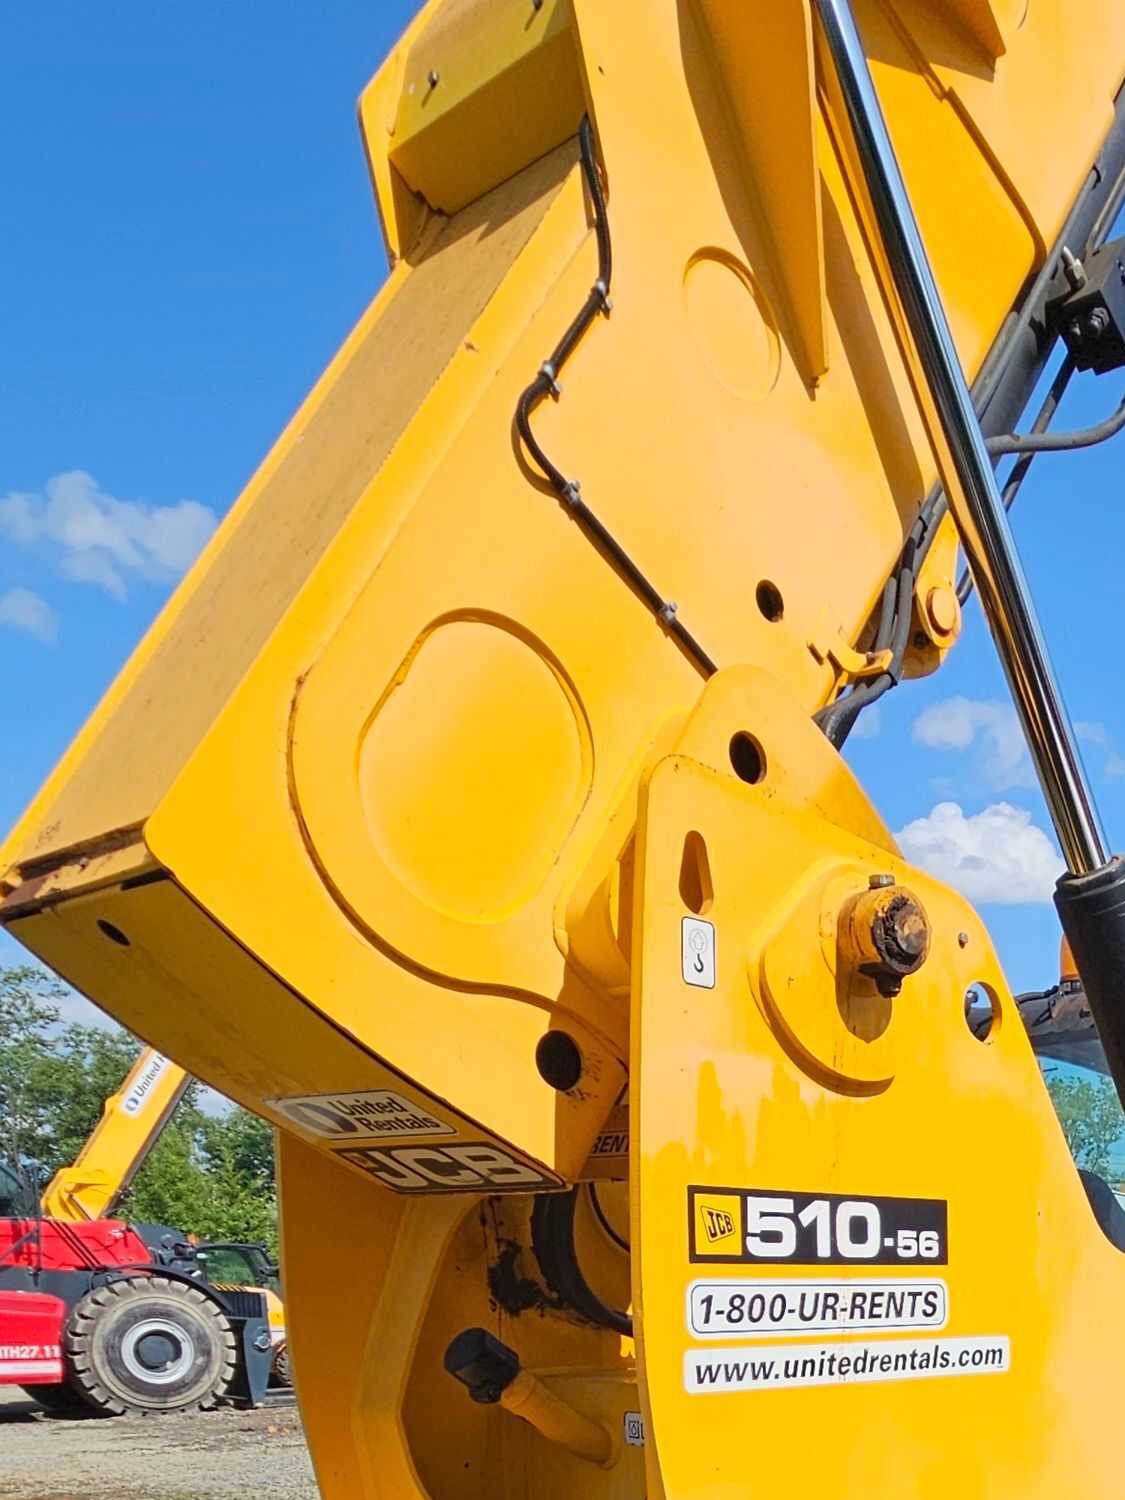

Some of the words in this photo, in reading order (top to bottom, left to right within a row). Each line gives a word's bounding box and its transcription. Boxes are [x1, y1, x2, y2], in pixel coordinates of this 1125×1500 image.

[133, 1060, 161, 1097] United
[326, 1096, 409, 1116] United
[353, 1113, 441, 1132] Rentals
[366, 1145, 544, 1189] JCB
[707, 1210, 733, 1239] JCB
[746, 1196, 939, 1258] 510-56
[699, 1290, 938, 1324] 1-800-UR-RENTS
[695, 1344, 1003, 1385] www.unitedrentals.com
